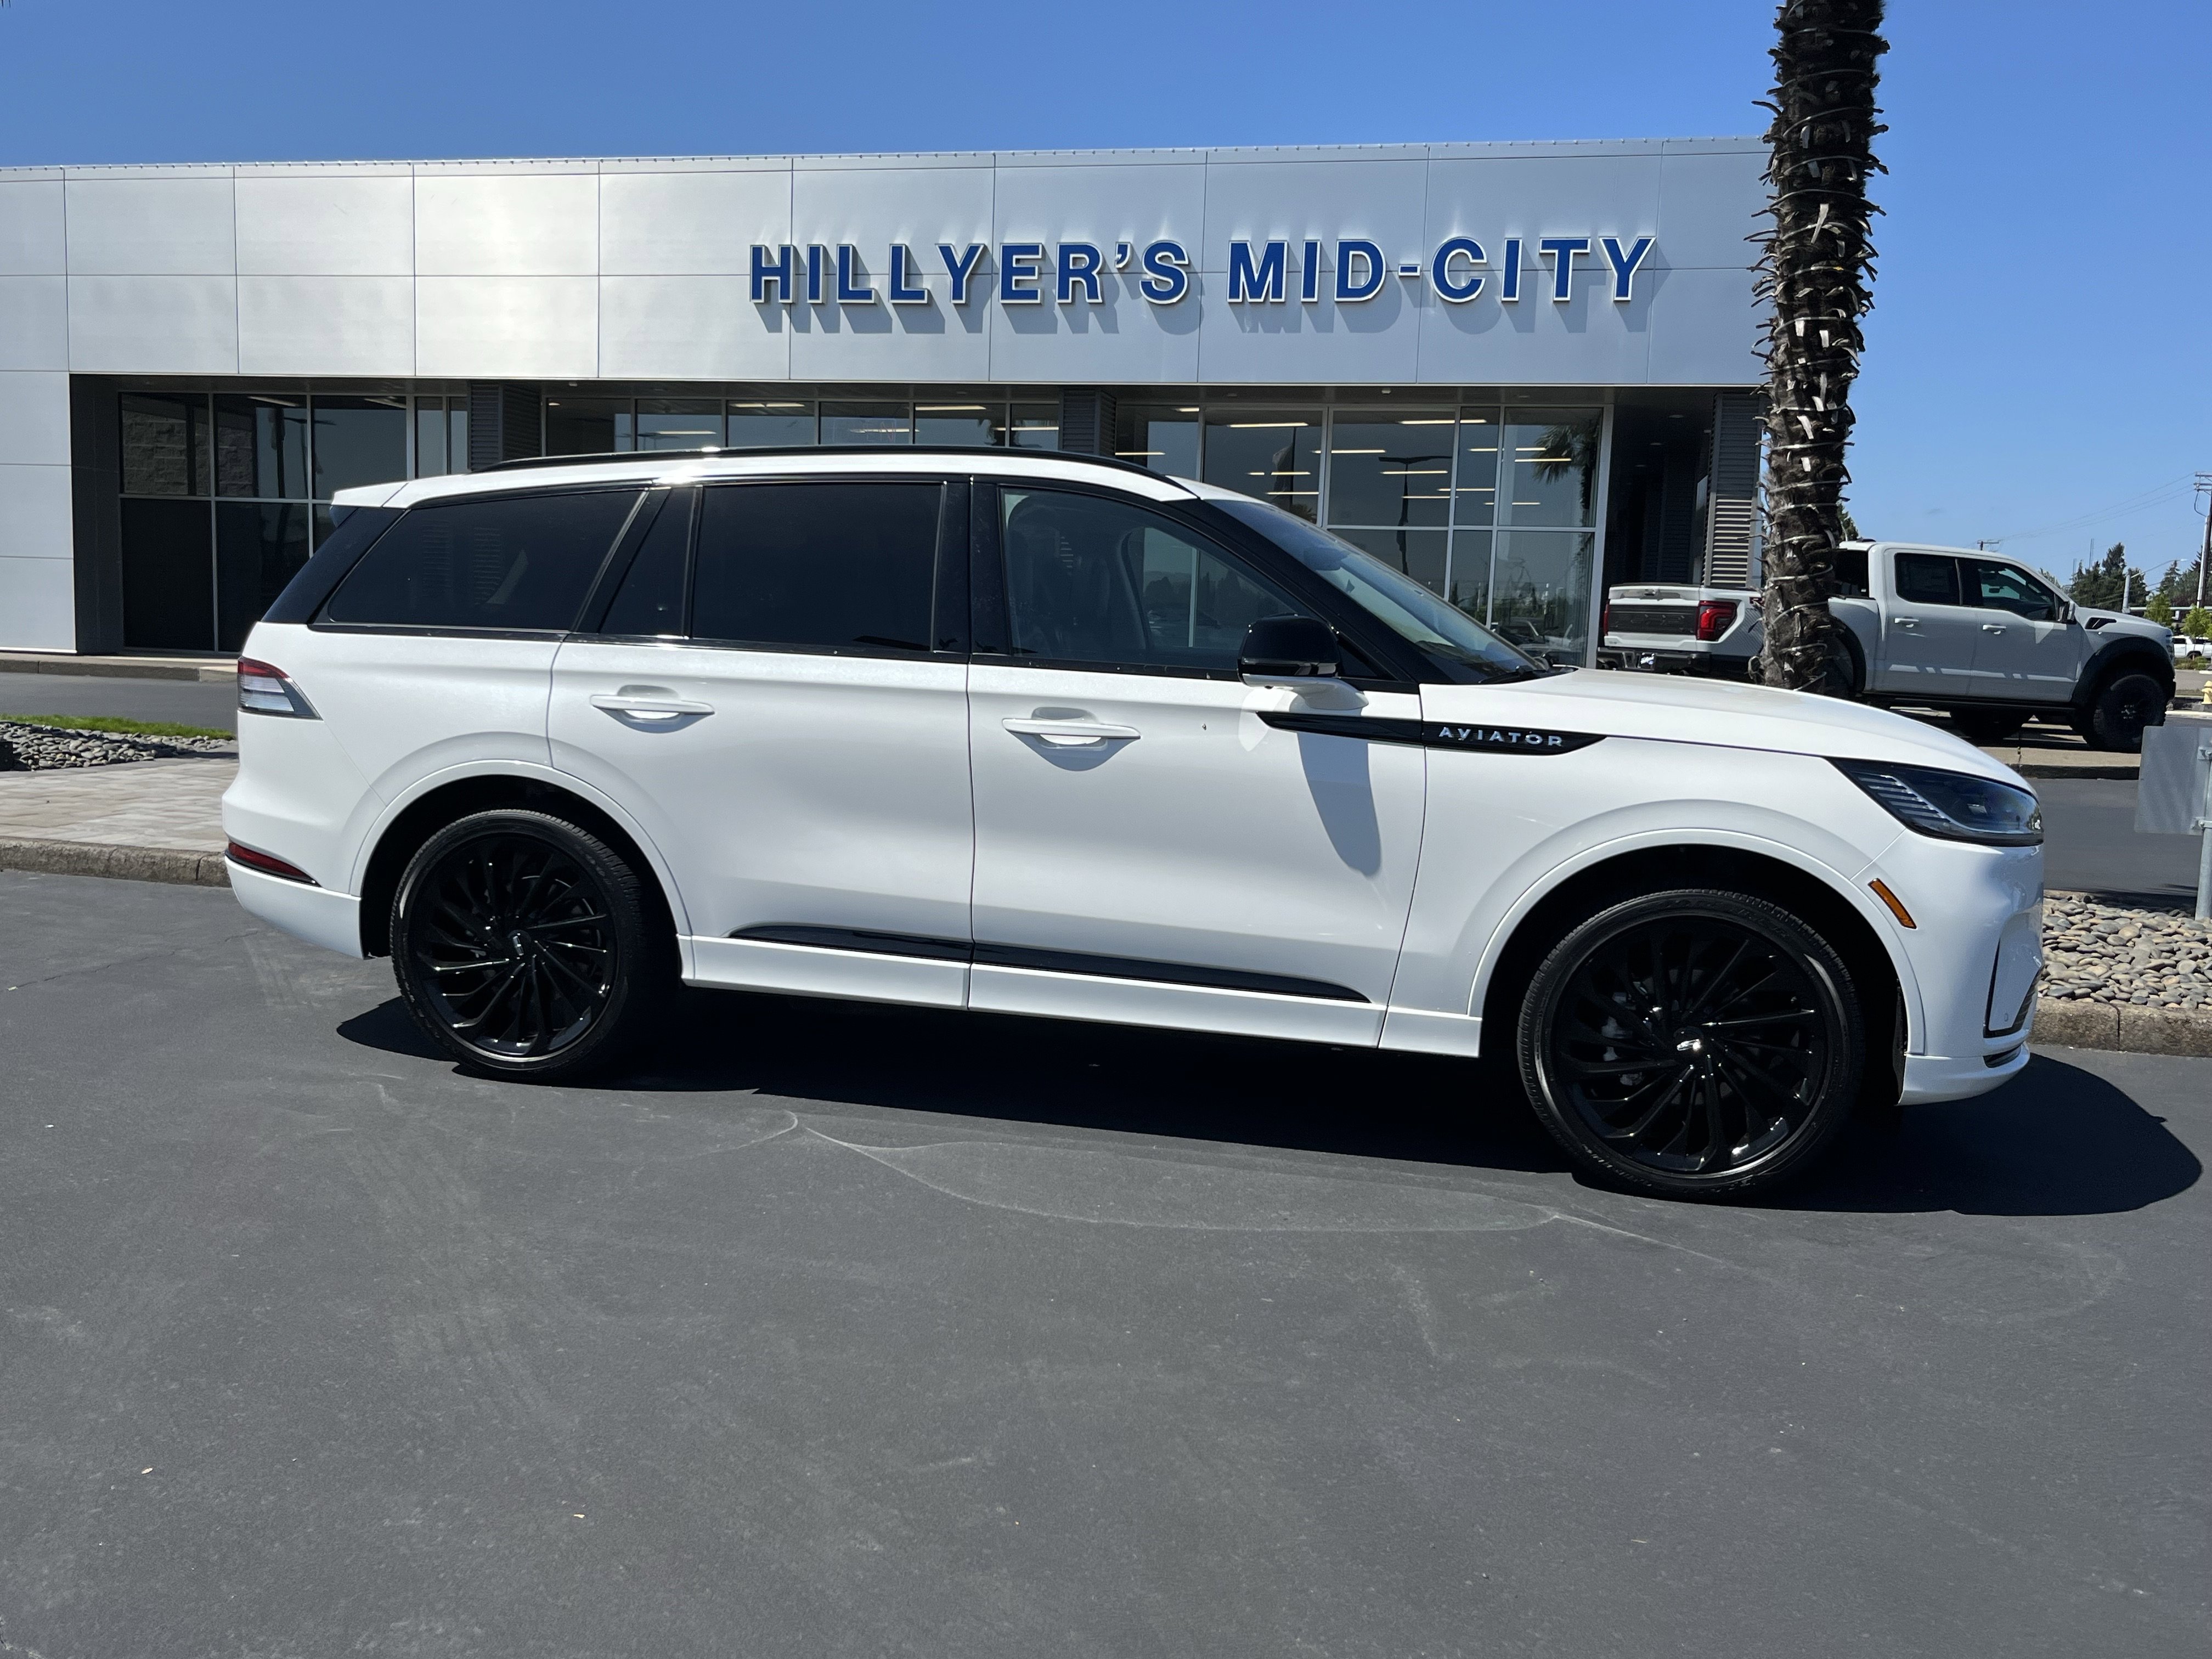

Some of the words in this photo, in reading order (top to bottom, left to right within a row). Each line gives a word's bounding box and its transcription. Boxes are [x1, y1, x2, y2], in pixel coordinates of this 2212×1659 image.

[749, 240, 1189, 305] HILLYER'S
[1227, 236, 1657, 303] MID-CITY
[1438, 726, 1564, 747] AVIATOR
